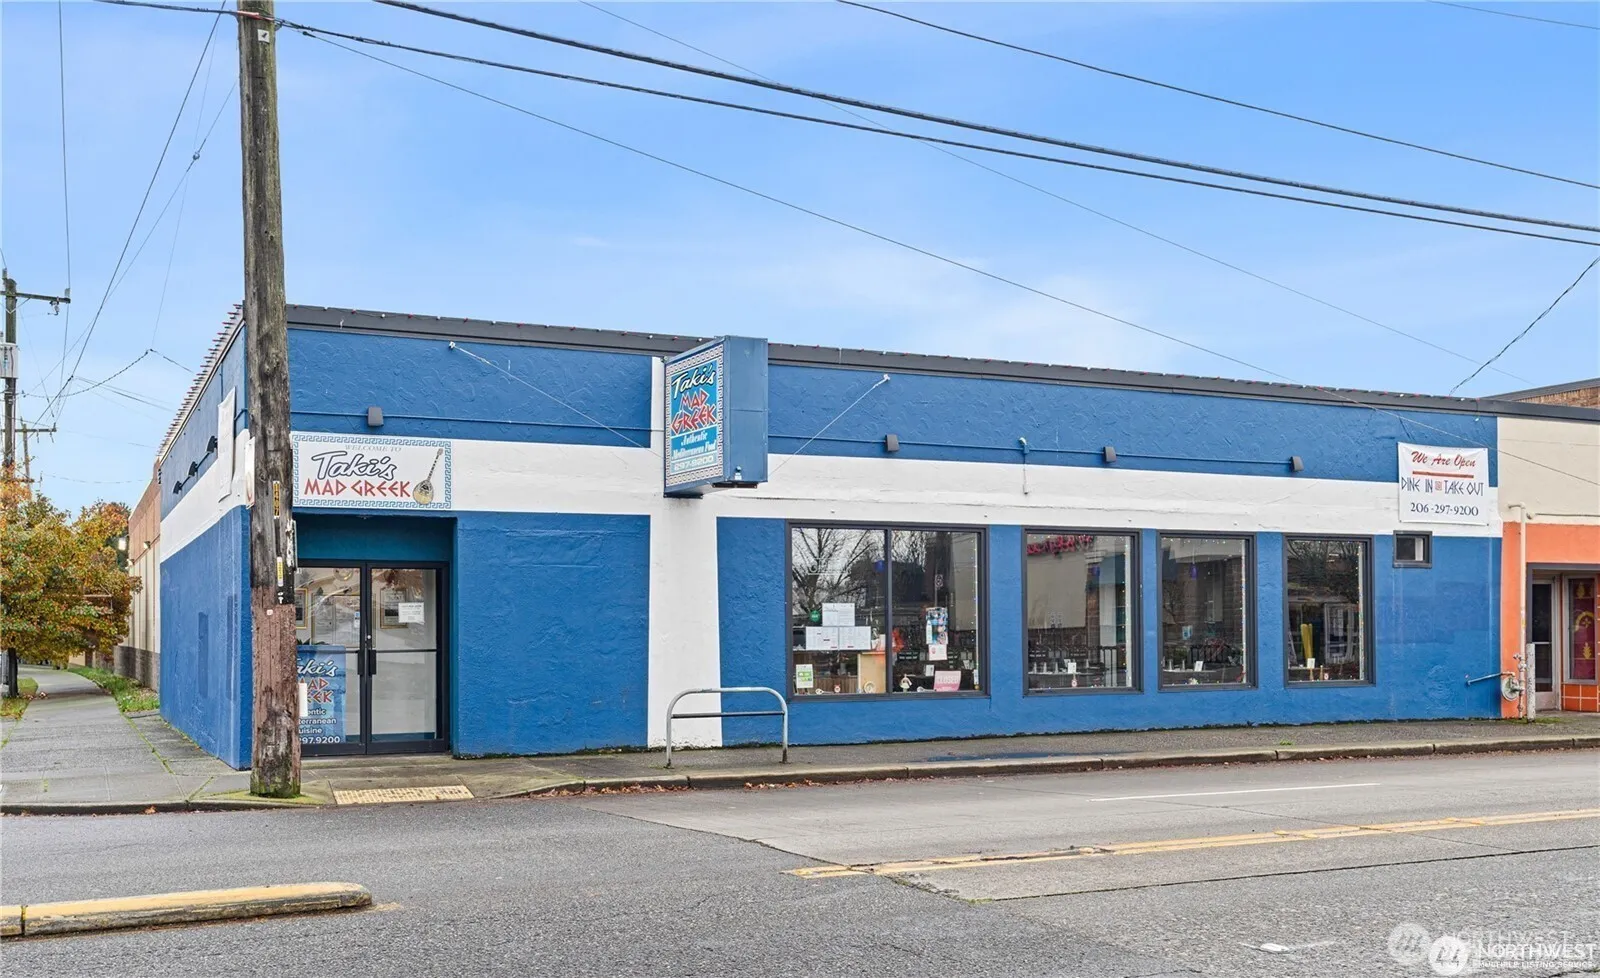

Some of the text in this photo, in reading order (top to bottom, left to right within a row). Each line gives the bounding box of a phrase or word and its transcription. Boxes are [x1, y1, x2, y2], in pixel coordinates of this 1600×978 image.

[672, 364, 716, 399] Taki's
[680, 388, 710, 411] MAD
[671, 404, 717, 435] GREEK
[345, 444, 388, 452] WELCOME
[311, 450, 397, 481] Taki's
[1411, 451, 1476, 469] We Are Open
[304, 478, 411, 498] MAD GREEK
[1401, 476, 1421, 493] DINE
[1425, 478, 1433, 493] IN
[1444, 479, 1465, 495] TAKE
[1466, 482, 1484, 497] OUT
[1410, 502, 1479, 516] 206-297-9200
[297, 658, 338, 677] aki's
[299, 677, 328, 690] AD
[300, 736, 341, 744] 97.9200
